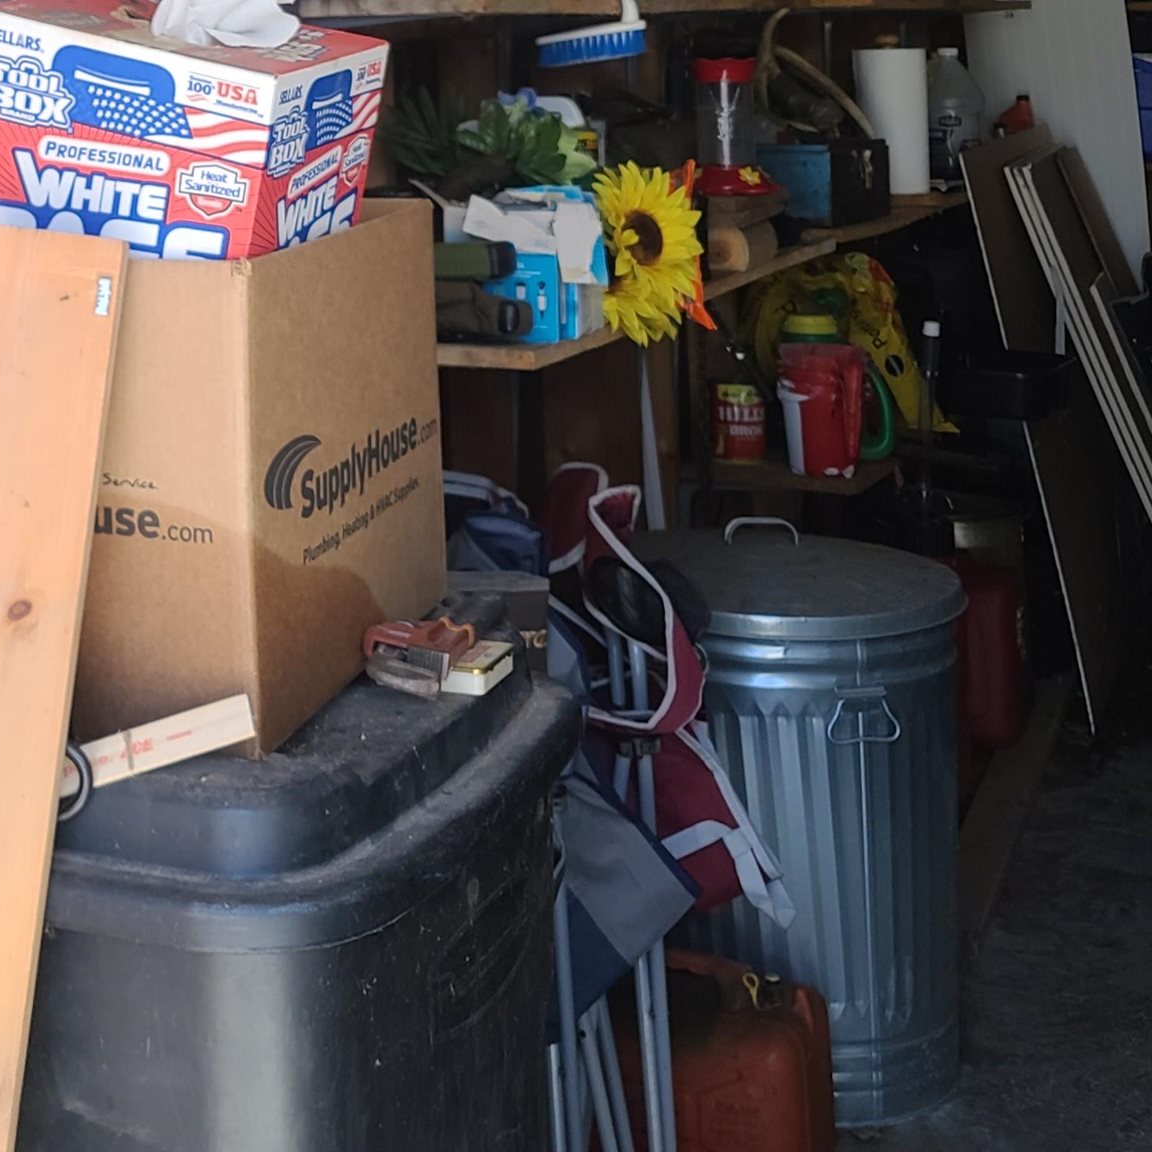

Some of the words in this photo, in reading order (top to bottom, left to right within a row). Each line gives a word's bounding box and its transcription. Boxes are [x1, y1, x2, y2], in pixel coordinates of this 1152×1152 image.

[216, 81, 259, 106] USA
[274, 119, 308, 144] TOOL
[44, 140, 164, 172] PROFESSIONAL
[270, 141, 306, 167] BOX
[13, 149, 169, 221] WHITE
[184, 179, 241, 199] Sanitized
[200, 169, 227, 182] Heat
[290, 153, 340, 195] PROFESSIONAL
[277, 175, 338, 248] WHITE
[300, 416, 438, 519] SupplyHouse.com
[302, 530, 342, 566] Plumbing,
[341, 511, 369, 541] Heating
